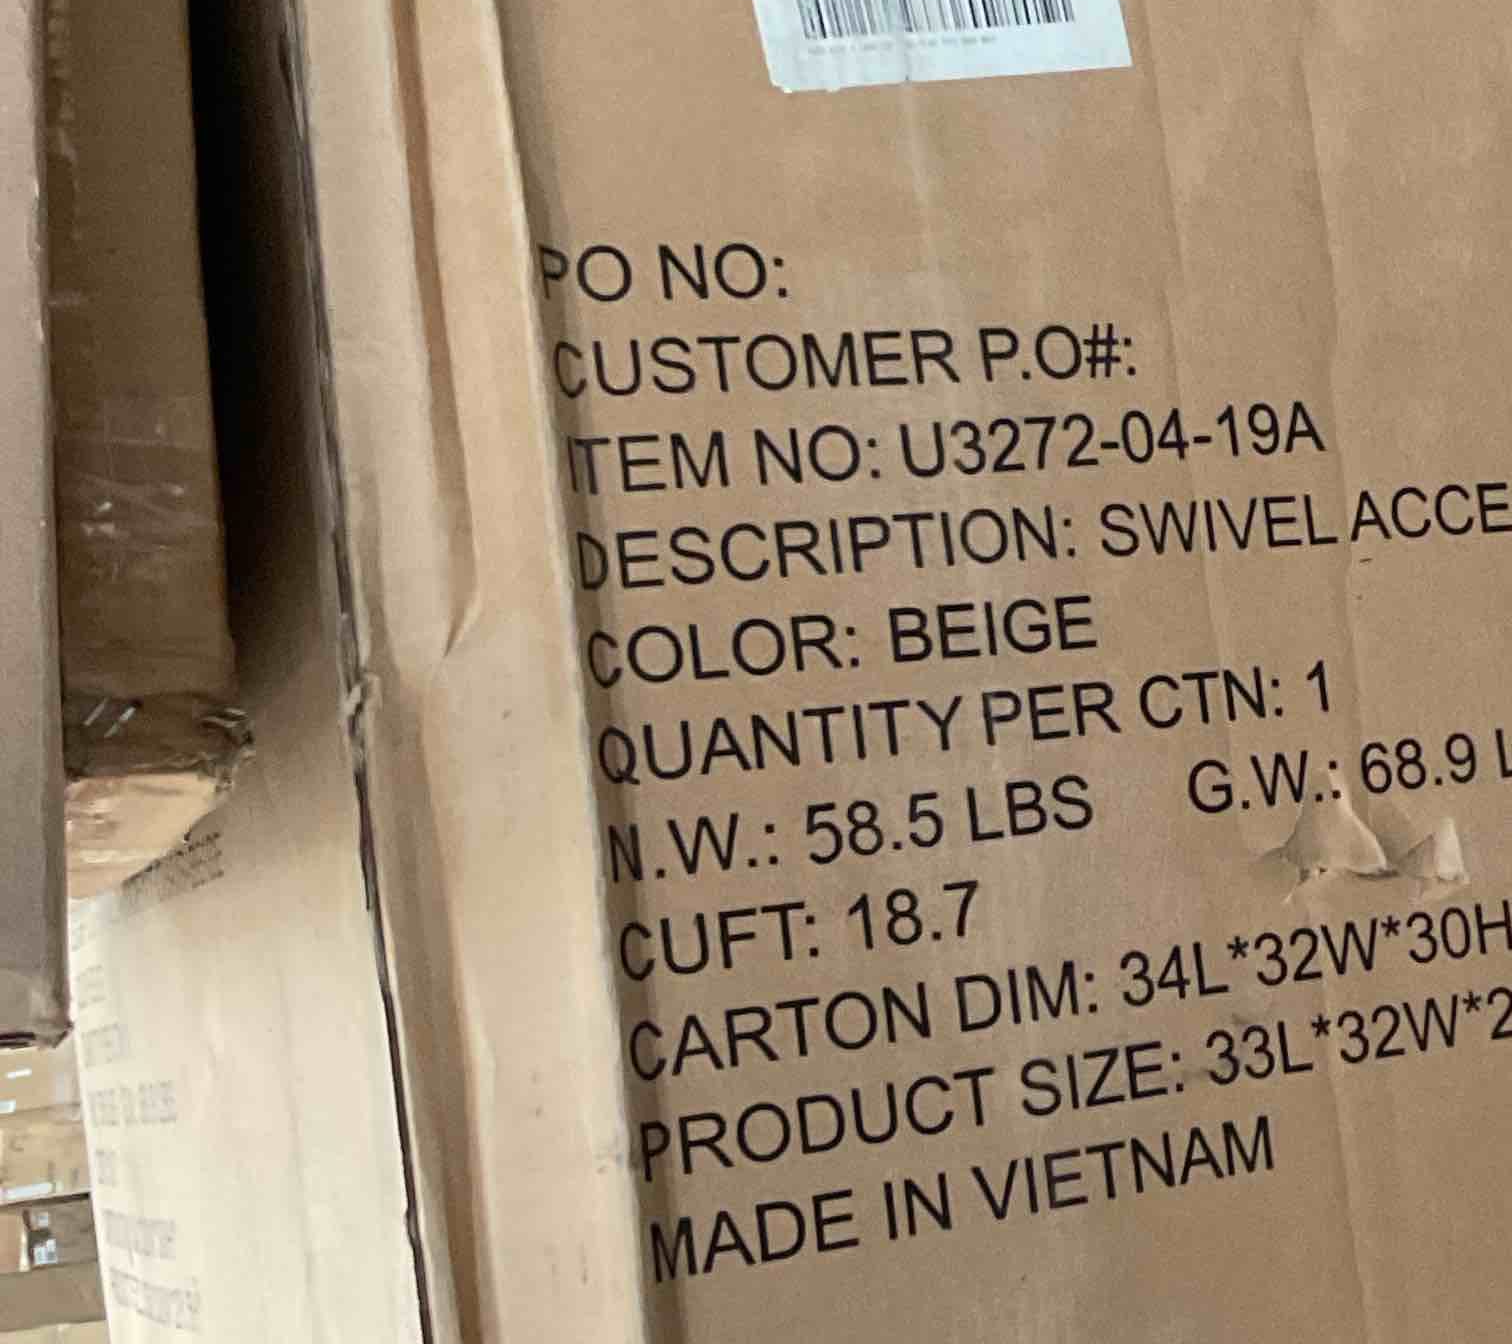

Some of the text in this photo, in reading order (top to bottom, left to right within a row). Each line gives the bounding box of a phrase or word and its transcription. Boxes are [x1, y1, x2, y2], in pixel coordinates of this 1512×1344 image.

[538, 242, 790, 303] PO NO:
[554, 323, 1137, 398] CUSTOMER P.O#:
[567, 399, 1326, 495] ITEM NO: U3272-04-19A
[577, 506, 1077, 590] DESCRIPTION:
[1100, 494, 1339, 558] SWIVEL
[588, 595, 1098, 688] COLOR: BEIGE
[598, 659, 1332, 785] QUANTITY PER CTN: 1
[608, 811, 778, 884] N.W.:
[805, 794, 944, 864] 58.5
[967, 775, 1094, 841] LBS
[1187, 750, 1342, 816] G.W.:
[1360, 732, 1477, 796] 68.9
[619, 881, 980, 980] CUFT: 18.7
[628, 983, 932, 1081] CARTON
[956, 958, 1098, 1034] DIM:
[639, 1066, 995, 1182] PRODUCT
[1020, 1040, 1184, 1116] SIZE:
[651, 1117, 1274, 1283] MADE IN VIETNAM
